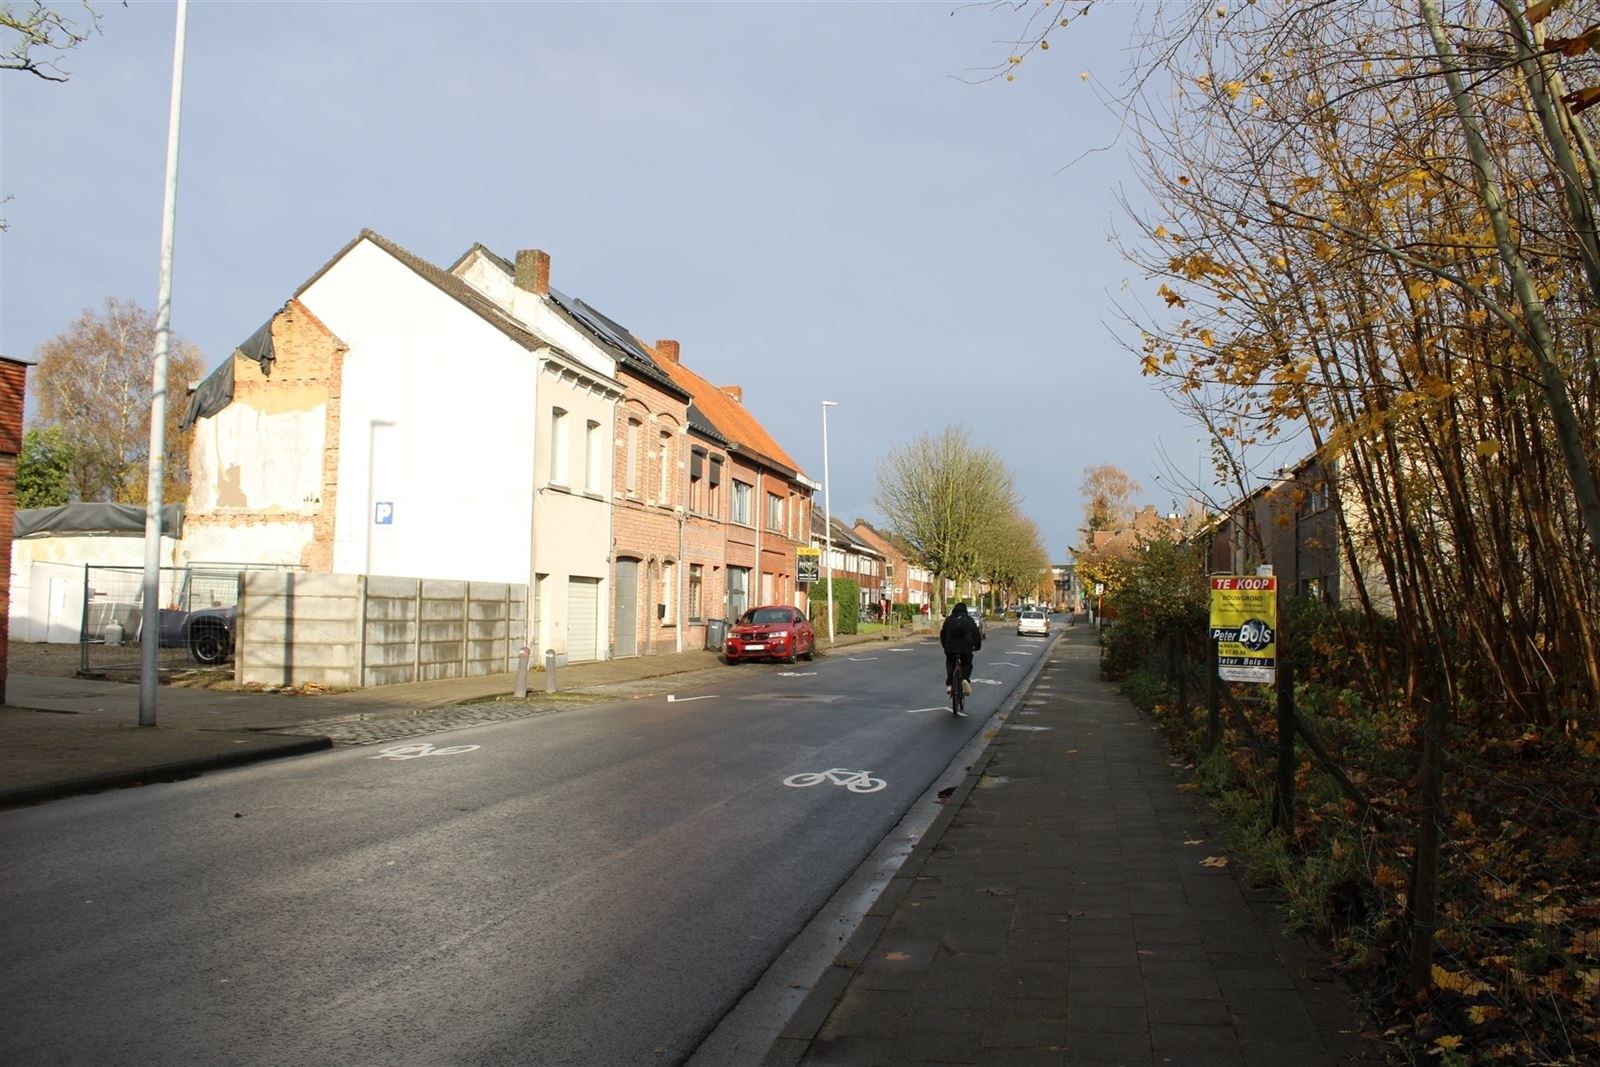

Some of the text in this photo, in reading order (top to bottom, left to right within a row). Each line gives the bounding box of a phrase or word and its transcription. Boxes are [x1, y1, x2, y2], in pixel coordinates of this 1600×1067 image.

[377, 504, 392, 522] P
[1216, 579, 1270, 590] TE KOOP
[1213, 624, 1272, 643] Peter Bols
[1243, 657, 1261, 666] Bols
